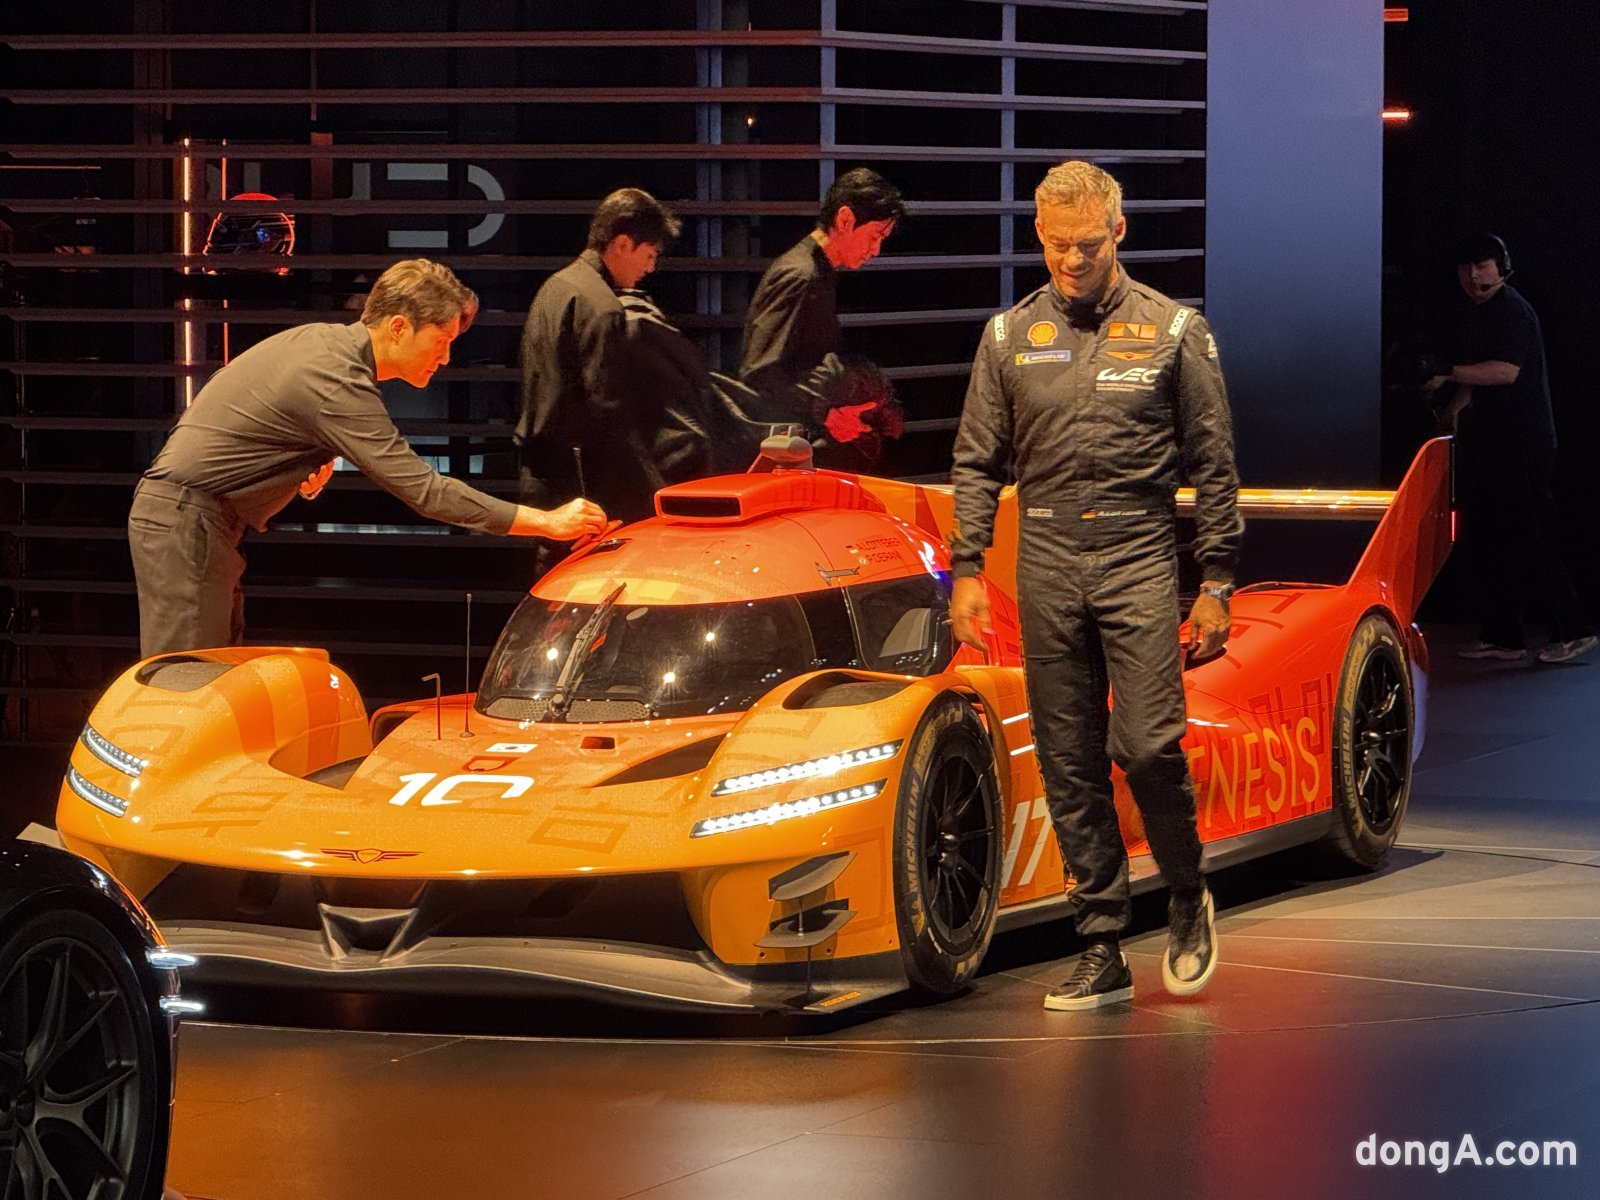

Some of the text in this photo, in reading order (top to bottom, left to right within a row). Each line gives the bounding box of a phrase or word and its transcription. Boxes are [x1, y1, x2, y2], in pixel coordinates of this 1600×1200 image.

[1096, 367, 1161, 384] WEC
[388, 773, 535, 806] 10
[1187, 717, 1320, 828] ENESIS
[1342, 716, 1357, 810] MICHELIN
[906, 778, 920, 893] MICHELIN
[1000, 796, 1052, 889] 17
